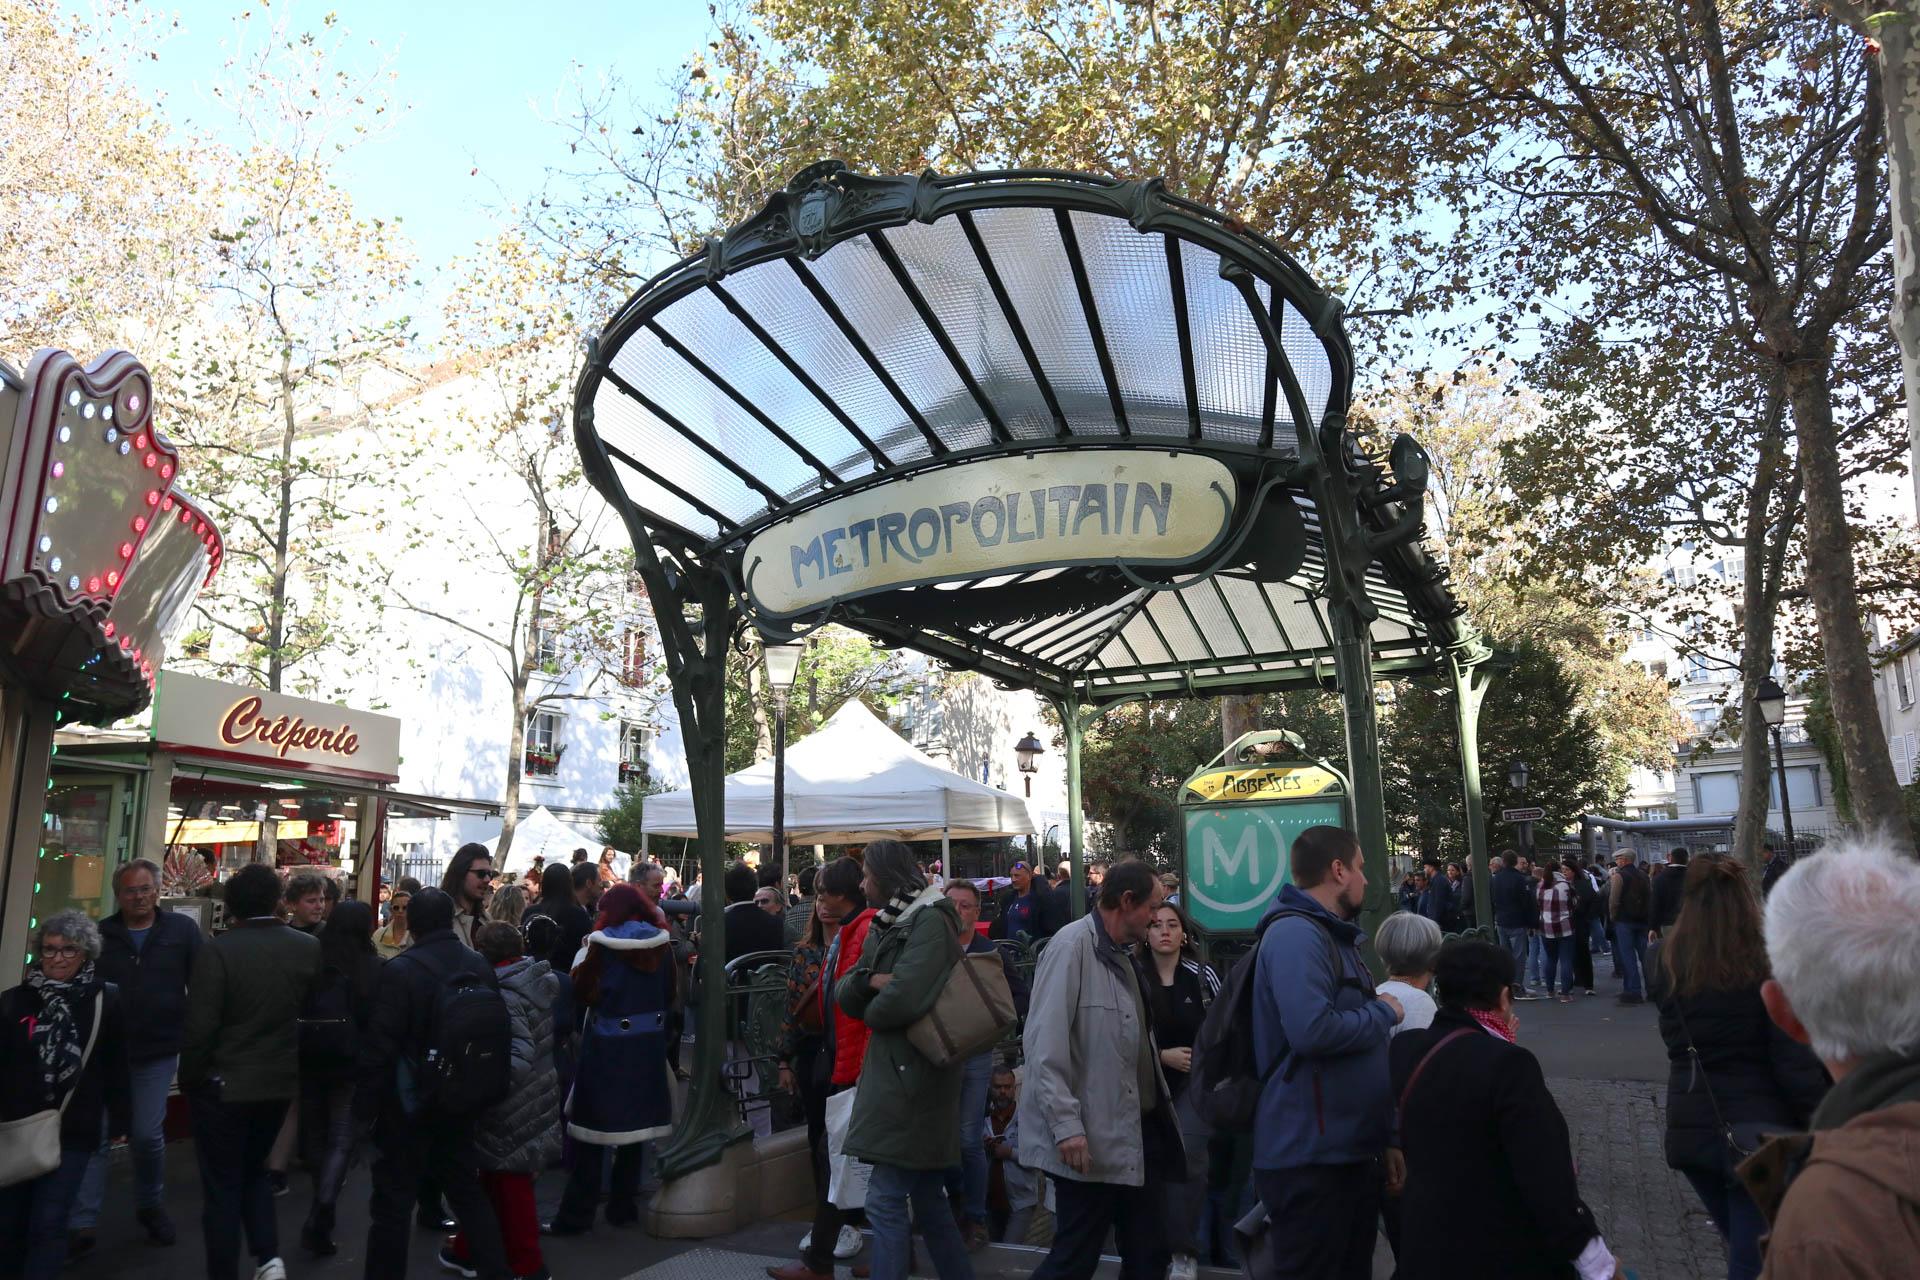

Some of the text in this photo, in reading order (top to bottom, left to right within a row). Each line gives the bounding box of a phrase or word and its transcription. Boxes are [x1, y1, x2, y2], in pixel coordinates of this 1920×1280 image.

[790, 482, 1172, 588] METROPOLITAIN
[221, 696, 360, 758] Crêperie
[1202, 824, 1260, 886] M
